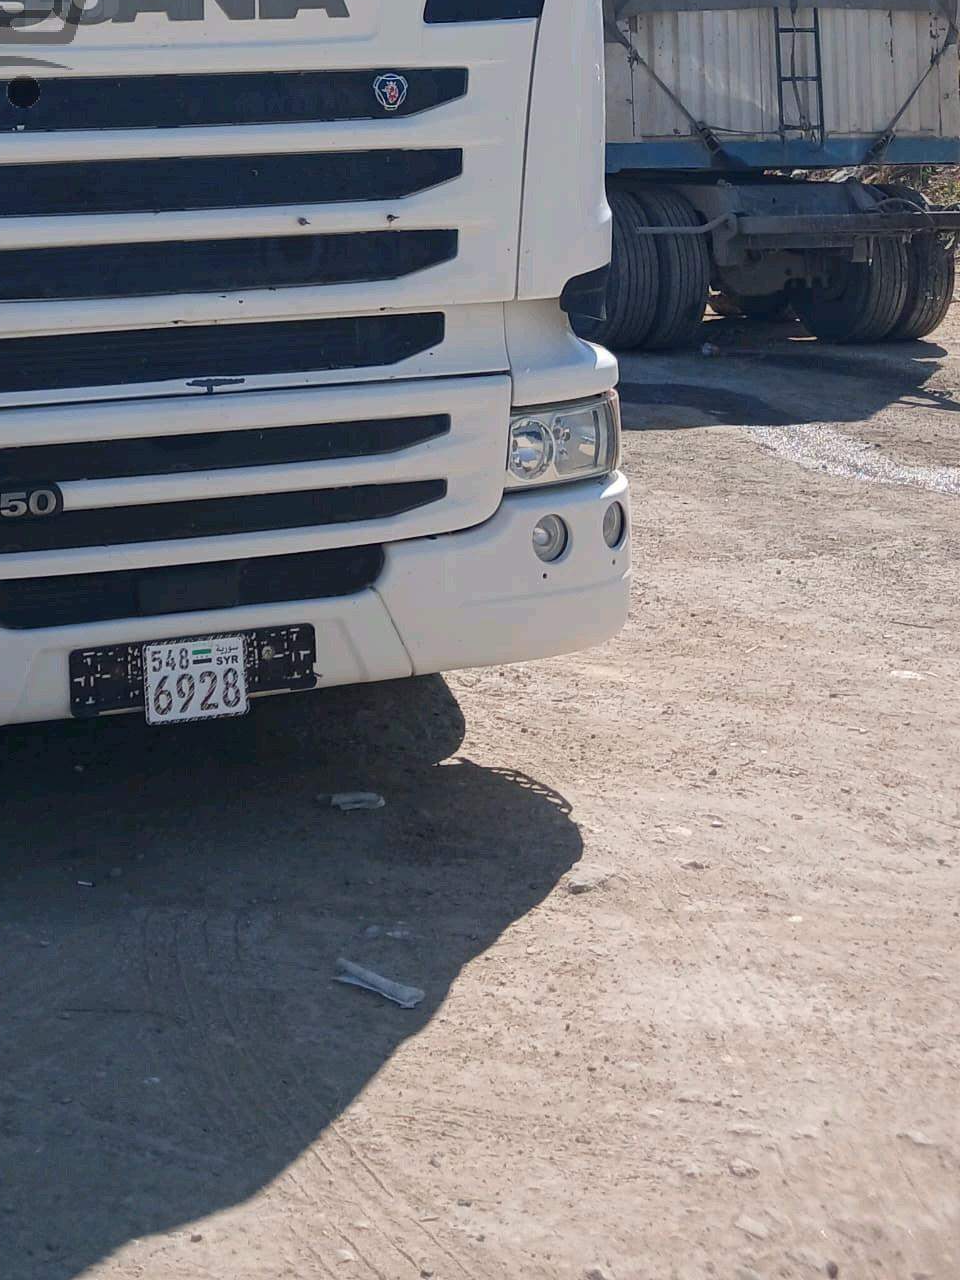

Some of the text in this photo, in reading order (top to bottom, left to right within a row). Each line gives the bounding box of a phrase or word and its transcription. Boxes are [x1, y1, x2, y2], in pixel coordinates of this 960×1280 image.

[151, 647, 189, 672] 548
[216, 655, 239, 666] SYR
[154, 668, 241, 716] 6928
